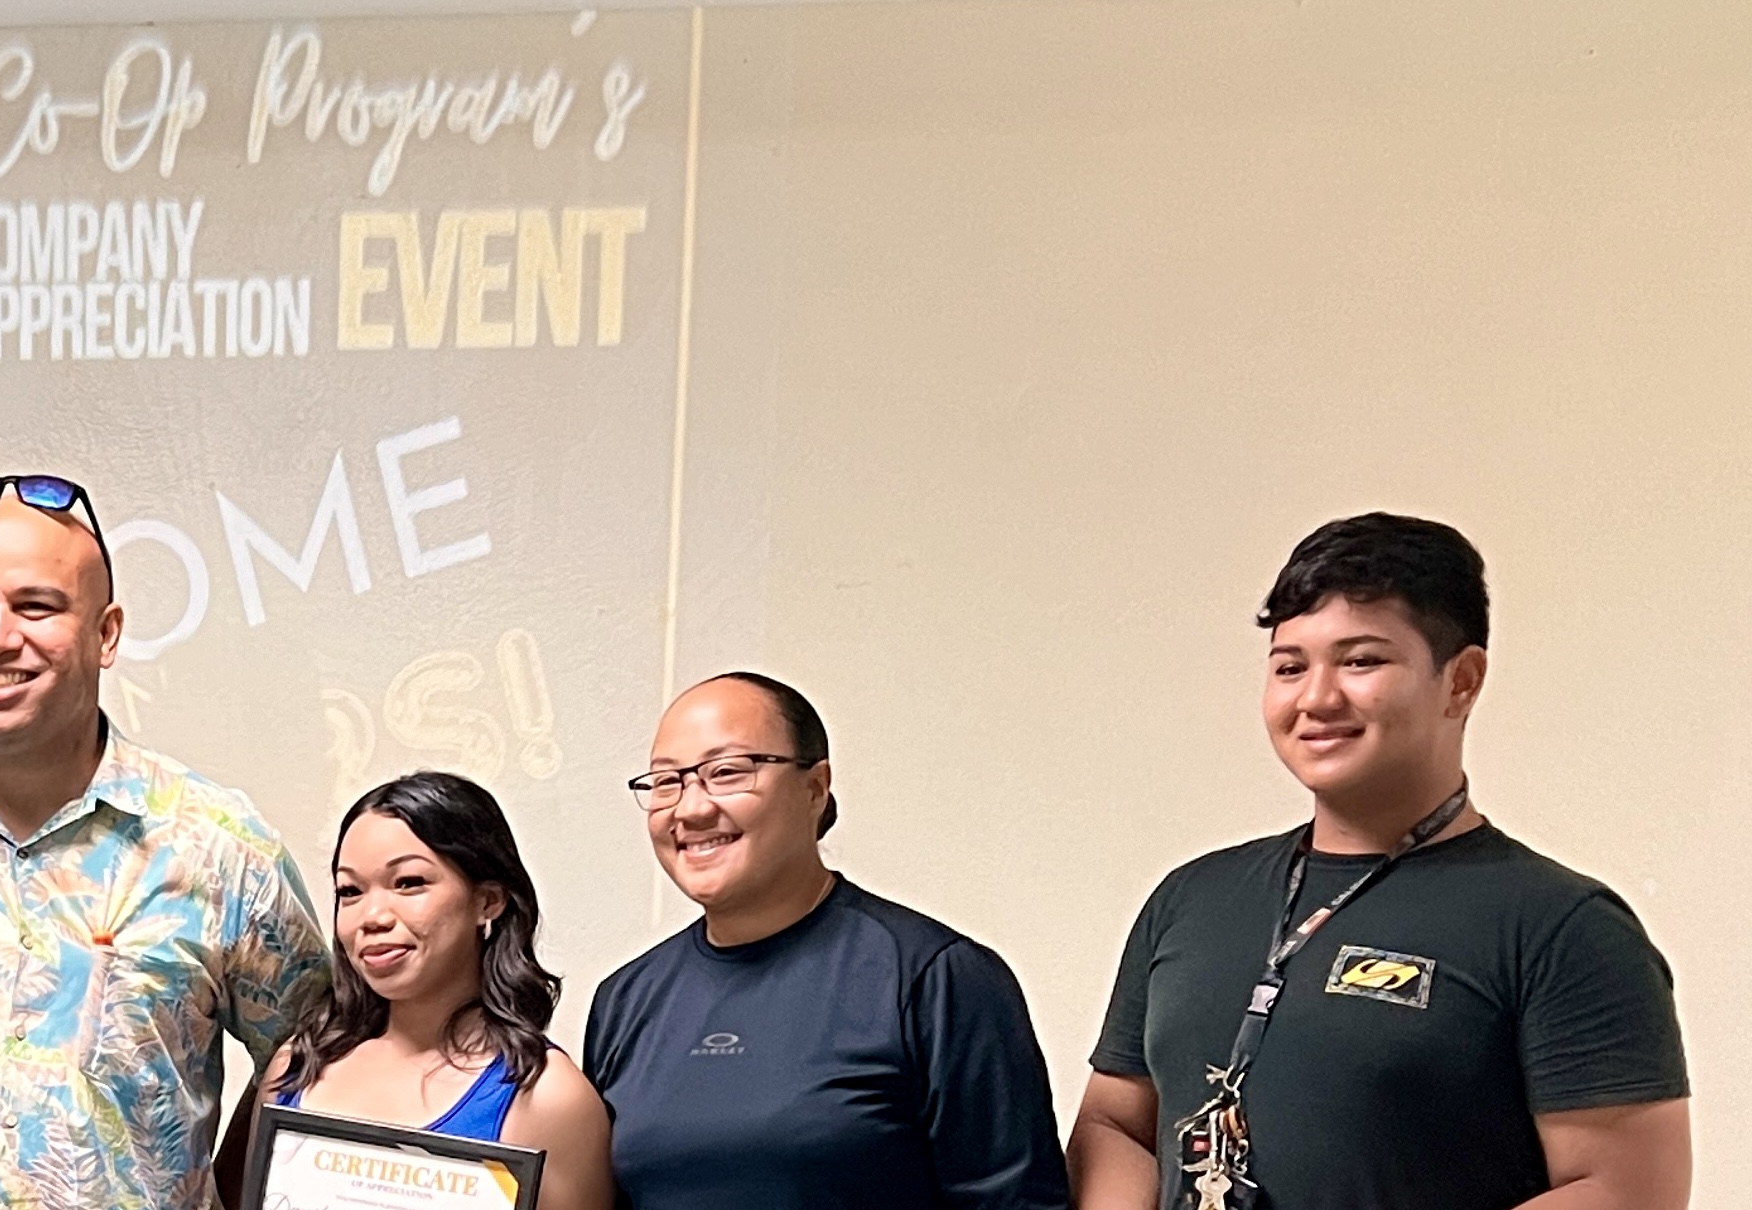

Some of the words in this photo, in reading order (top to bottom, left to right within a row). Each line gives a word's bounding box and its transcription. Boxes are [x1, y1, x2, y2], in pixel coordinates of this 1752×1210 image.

[247, 9, 648, 196] Program's
[337, 206, 647, 354] EVENT
[313, 1149, 480, 1197] CERTIFICATE
